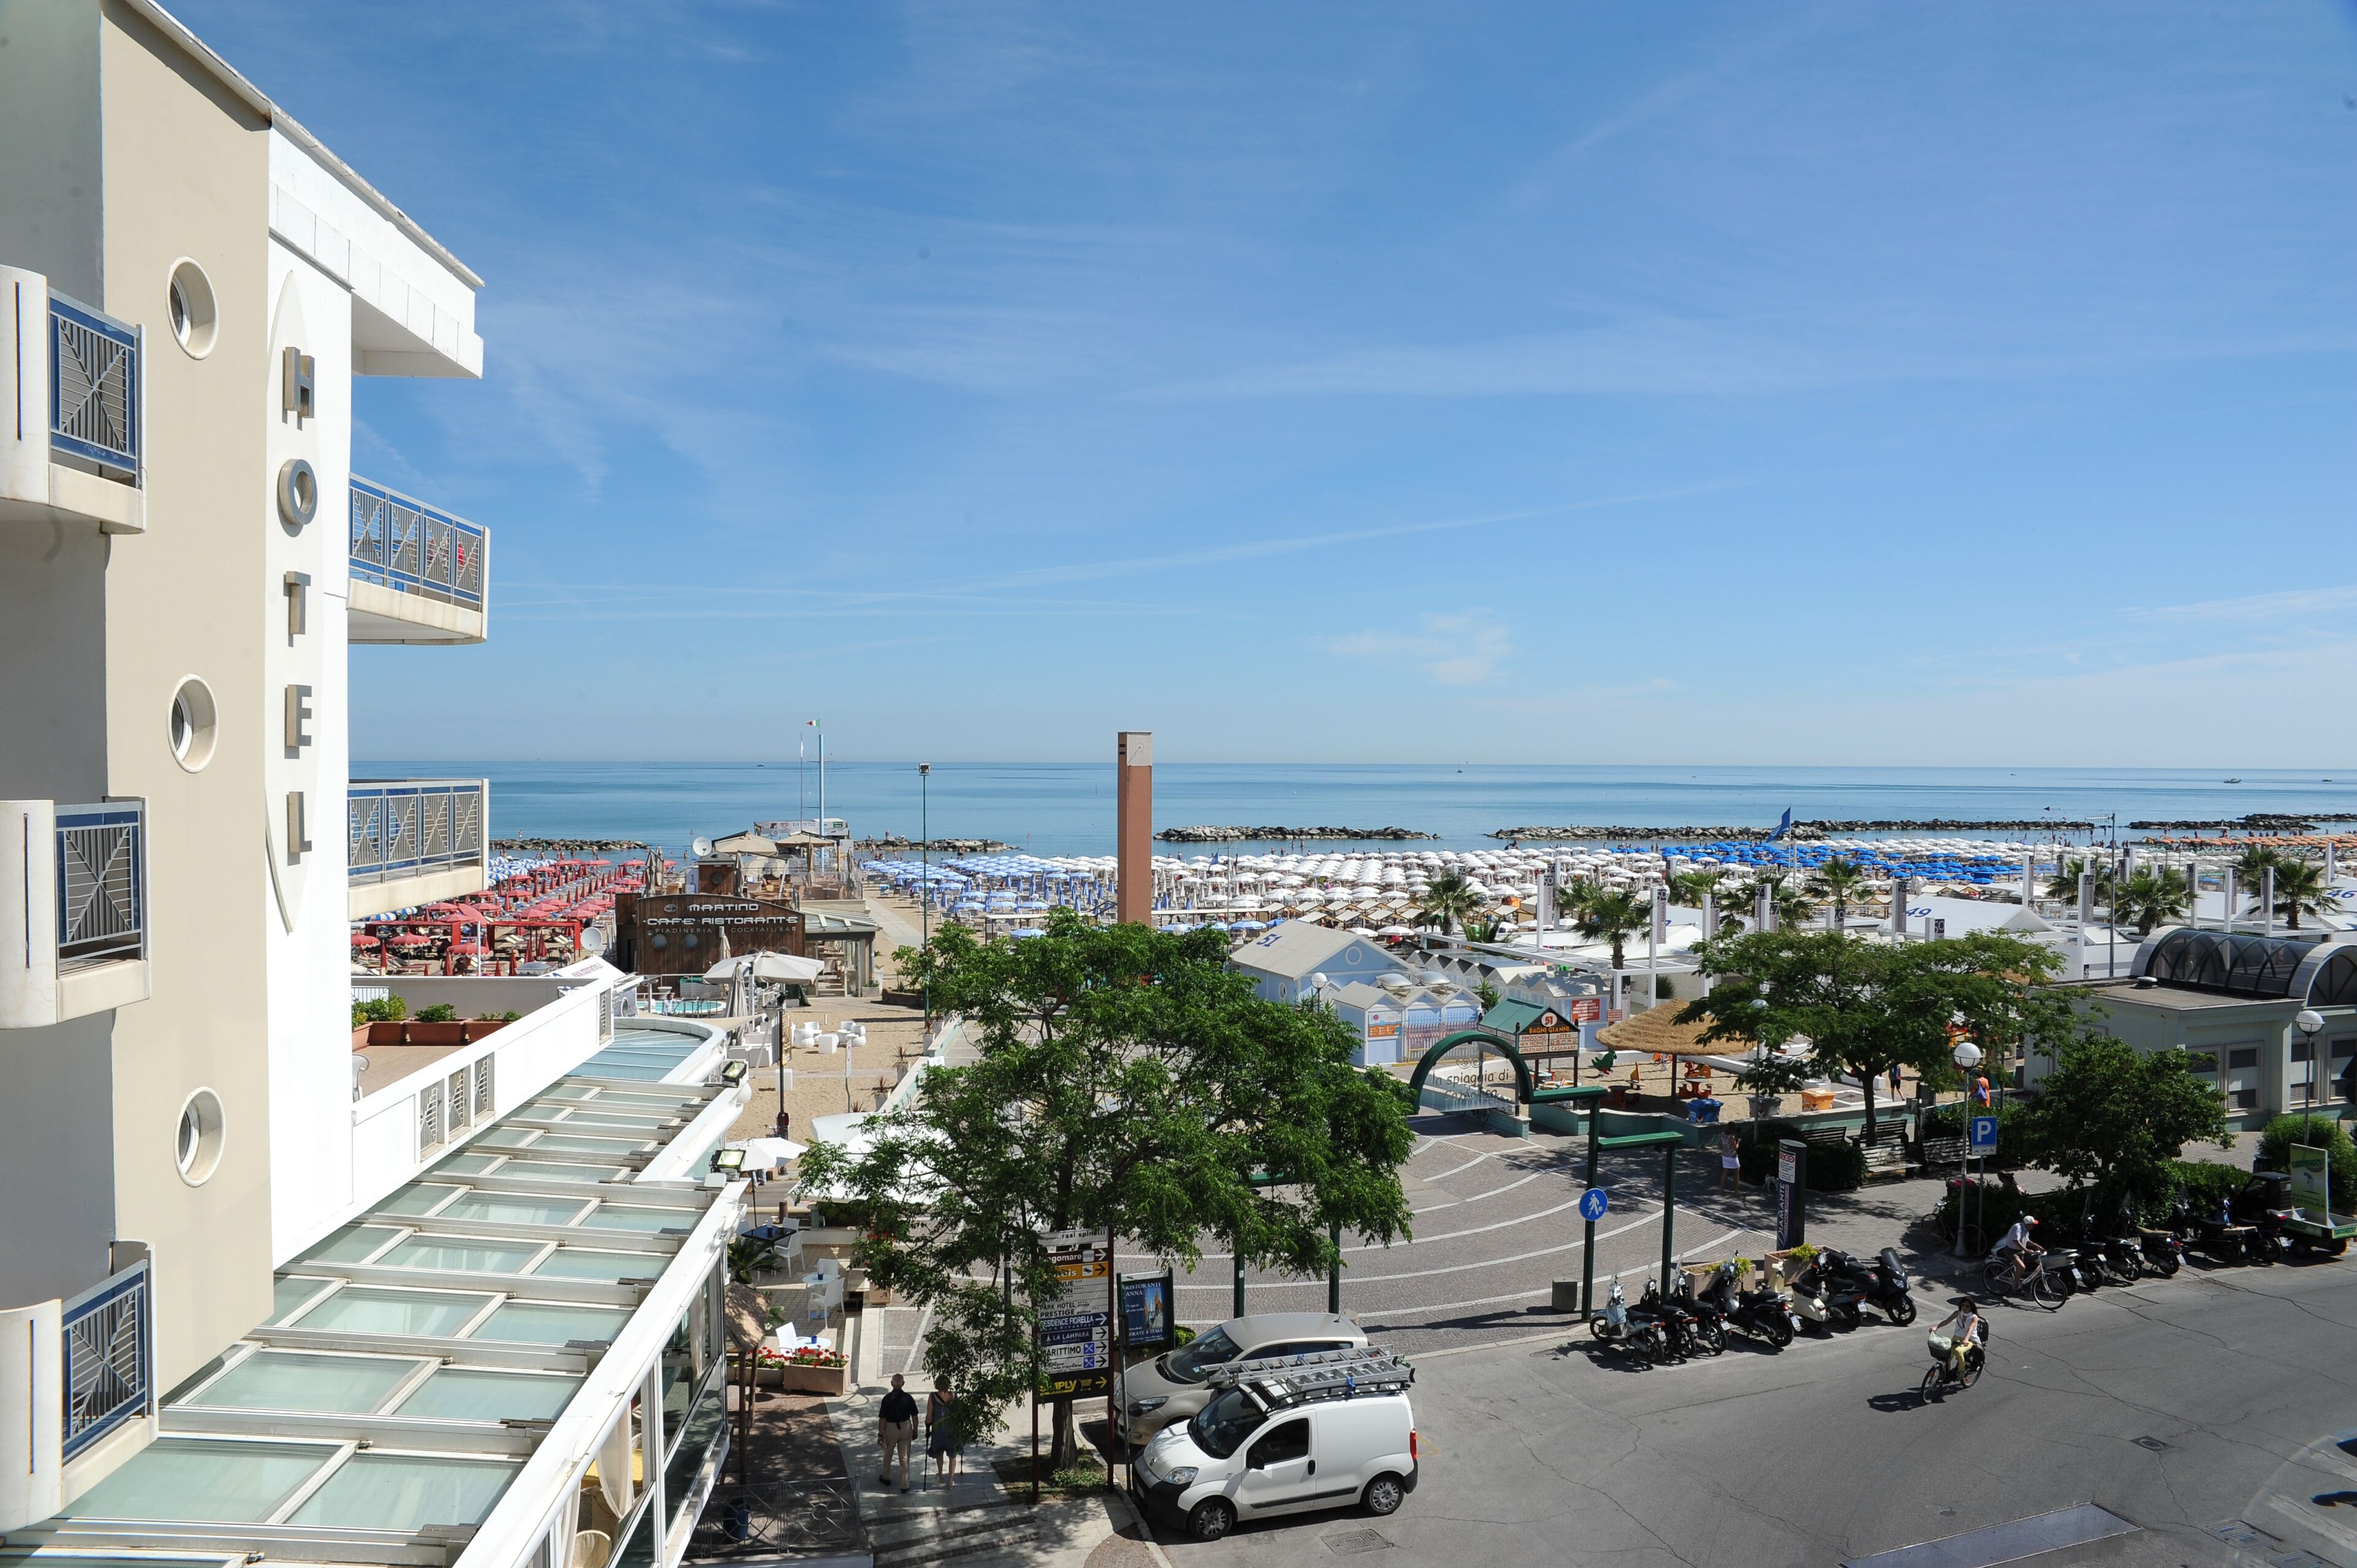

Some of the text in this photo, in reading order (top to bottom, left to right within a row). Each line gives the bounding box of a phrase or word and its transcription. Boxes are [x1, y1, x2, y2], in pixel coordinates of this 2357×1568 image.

[279, 347, 317, 851] HOTEL
[1657, 890, 1666, 900] 50
[2326, 889, 2357, 898] 46
[1905, 907, 1932, 917] 49
[702, 916, 798, 925] RISTORANTE
[1256, 933, 1282, 947] 51
[1544, 1016, 1553, 1025] 51
[1433, 1068, 1509, 1088] la spiaggia di
[1977, 1121, 1992, 1142] P
[1040, 1309, 1075, 1318] PRESTIGE
[1069, 1315, 1094, 1324] FIORELLA
[1062, 1331, 1089, 1340] LAMPARA
[1045, 1346, 1082, 1357] ARITTIMO
